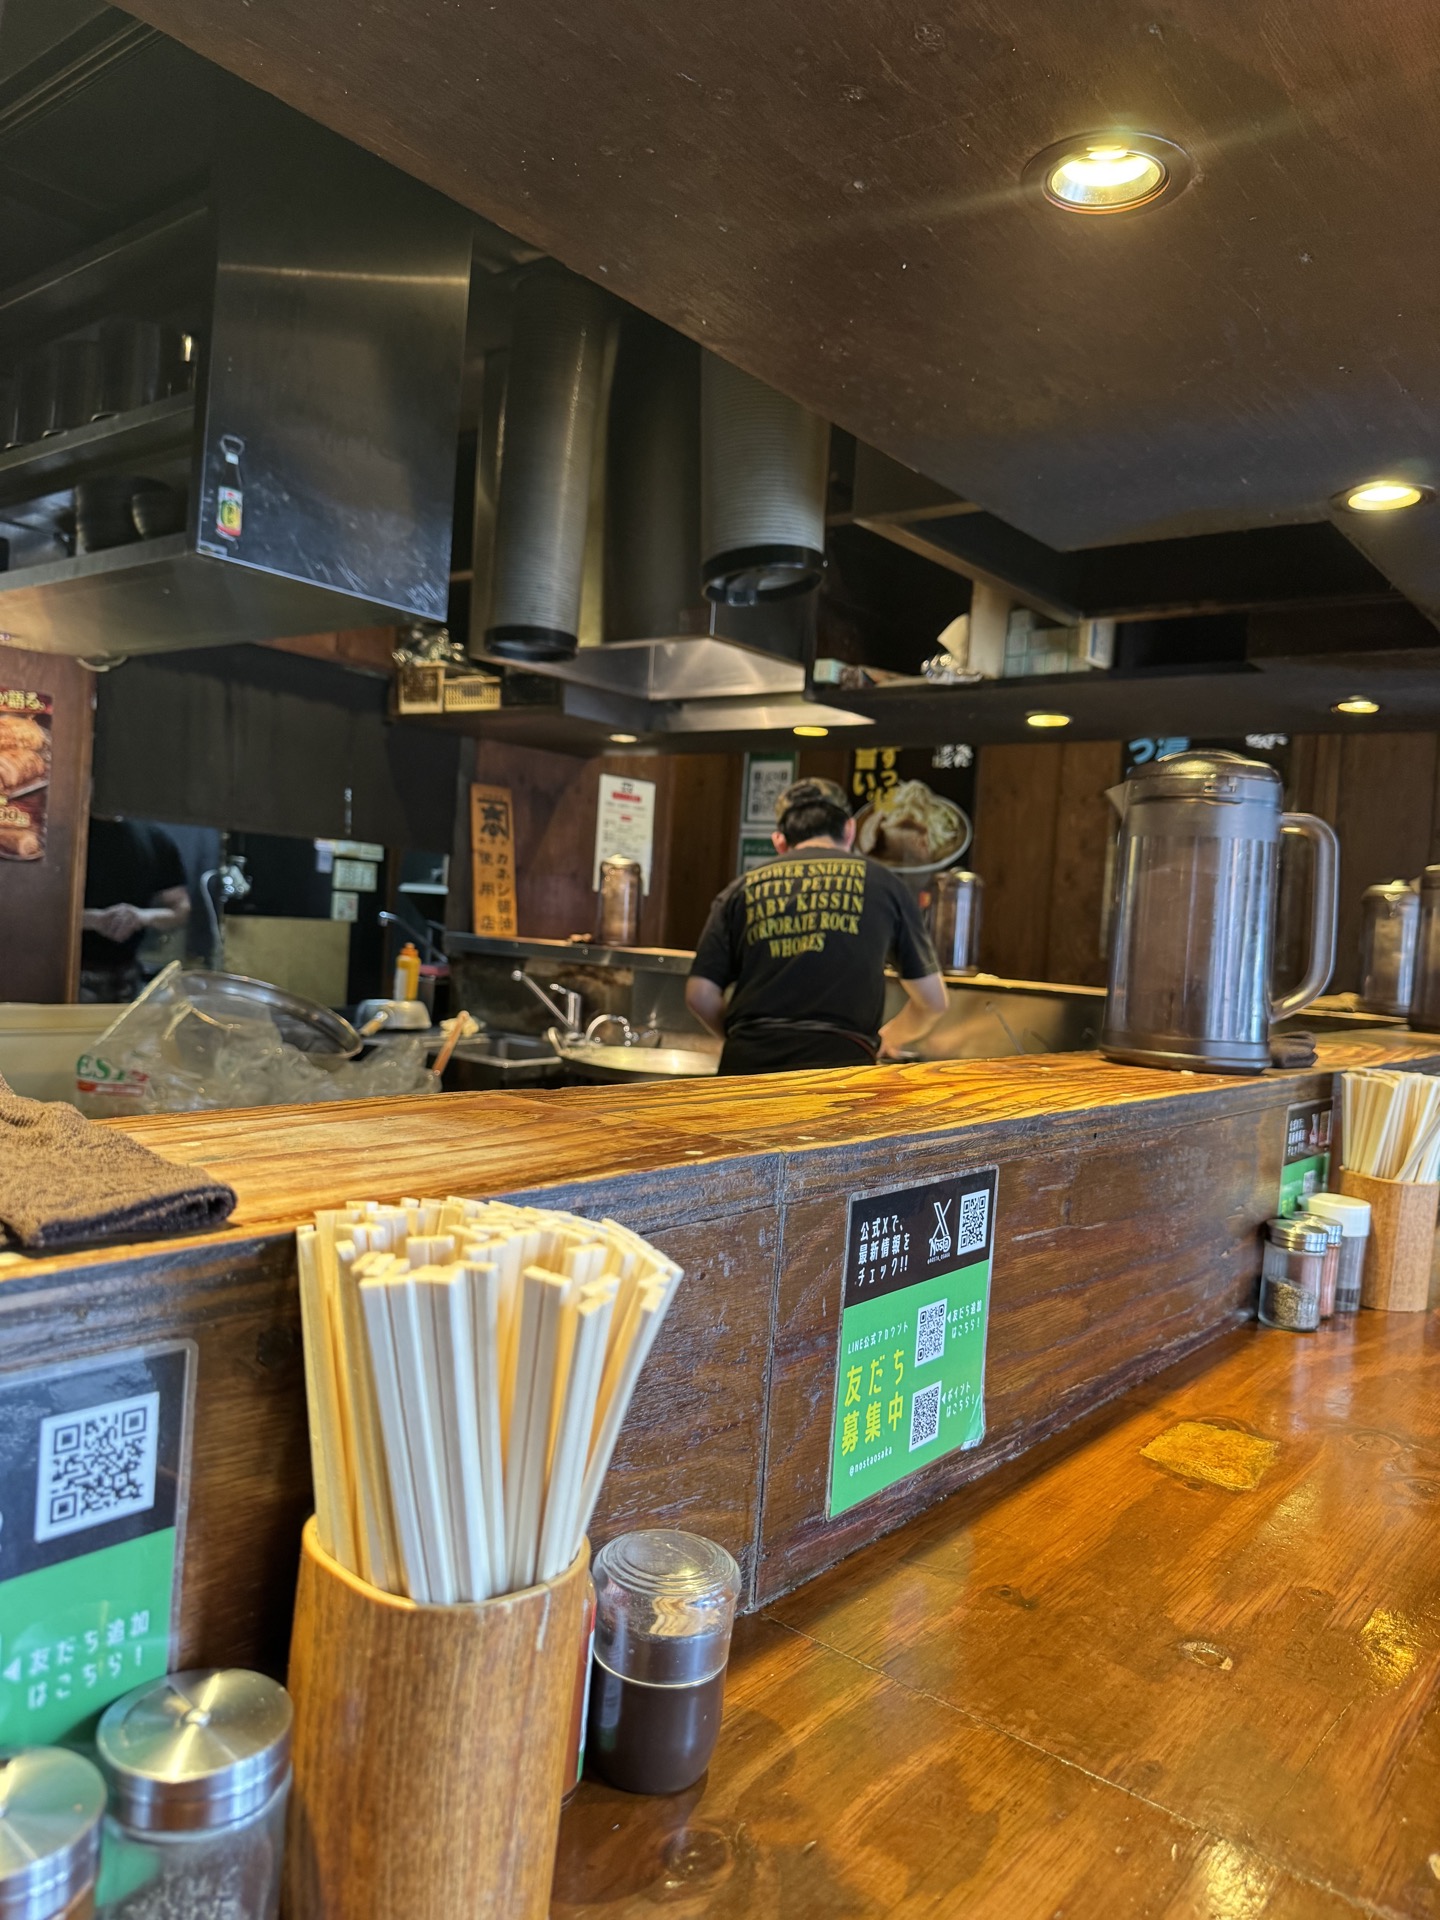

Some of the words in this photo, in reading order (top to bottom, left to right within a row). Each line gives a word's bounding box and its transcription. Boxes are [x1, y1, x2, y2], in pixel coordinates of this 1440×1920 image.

[808, 864, 866, 878] SNIFFIN
[745, 879, 795, 905] KITTY
[801, 876, 865, 894] PETTIN
[746, 896, 789, 925] BABY
[796, 892, 864, 914] KISSIN
[820, 911, 860, 935] ROCK
[861, 1215, 903, 1241] 公式Xで、
[858, 1233, 910, 1265] 最新情報を
[844, 1349, 905, 1407] 友だち
[842, 1391, 904, 1456] 募集中
[849, 1446, 893, 1476] @nostaosaka
[28, 1610, 150, 1676] 友だち追加
